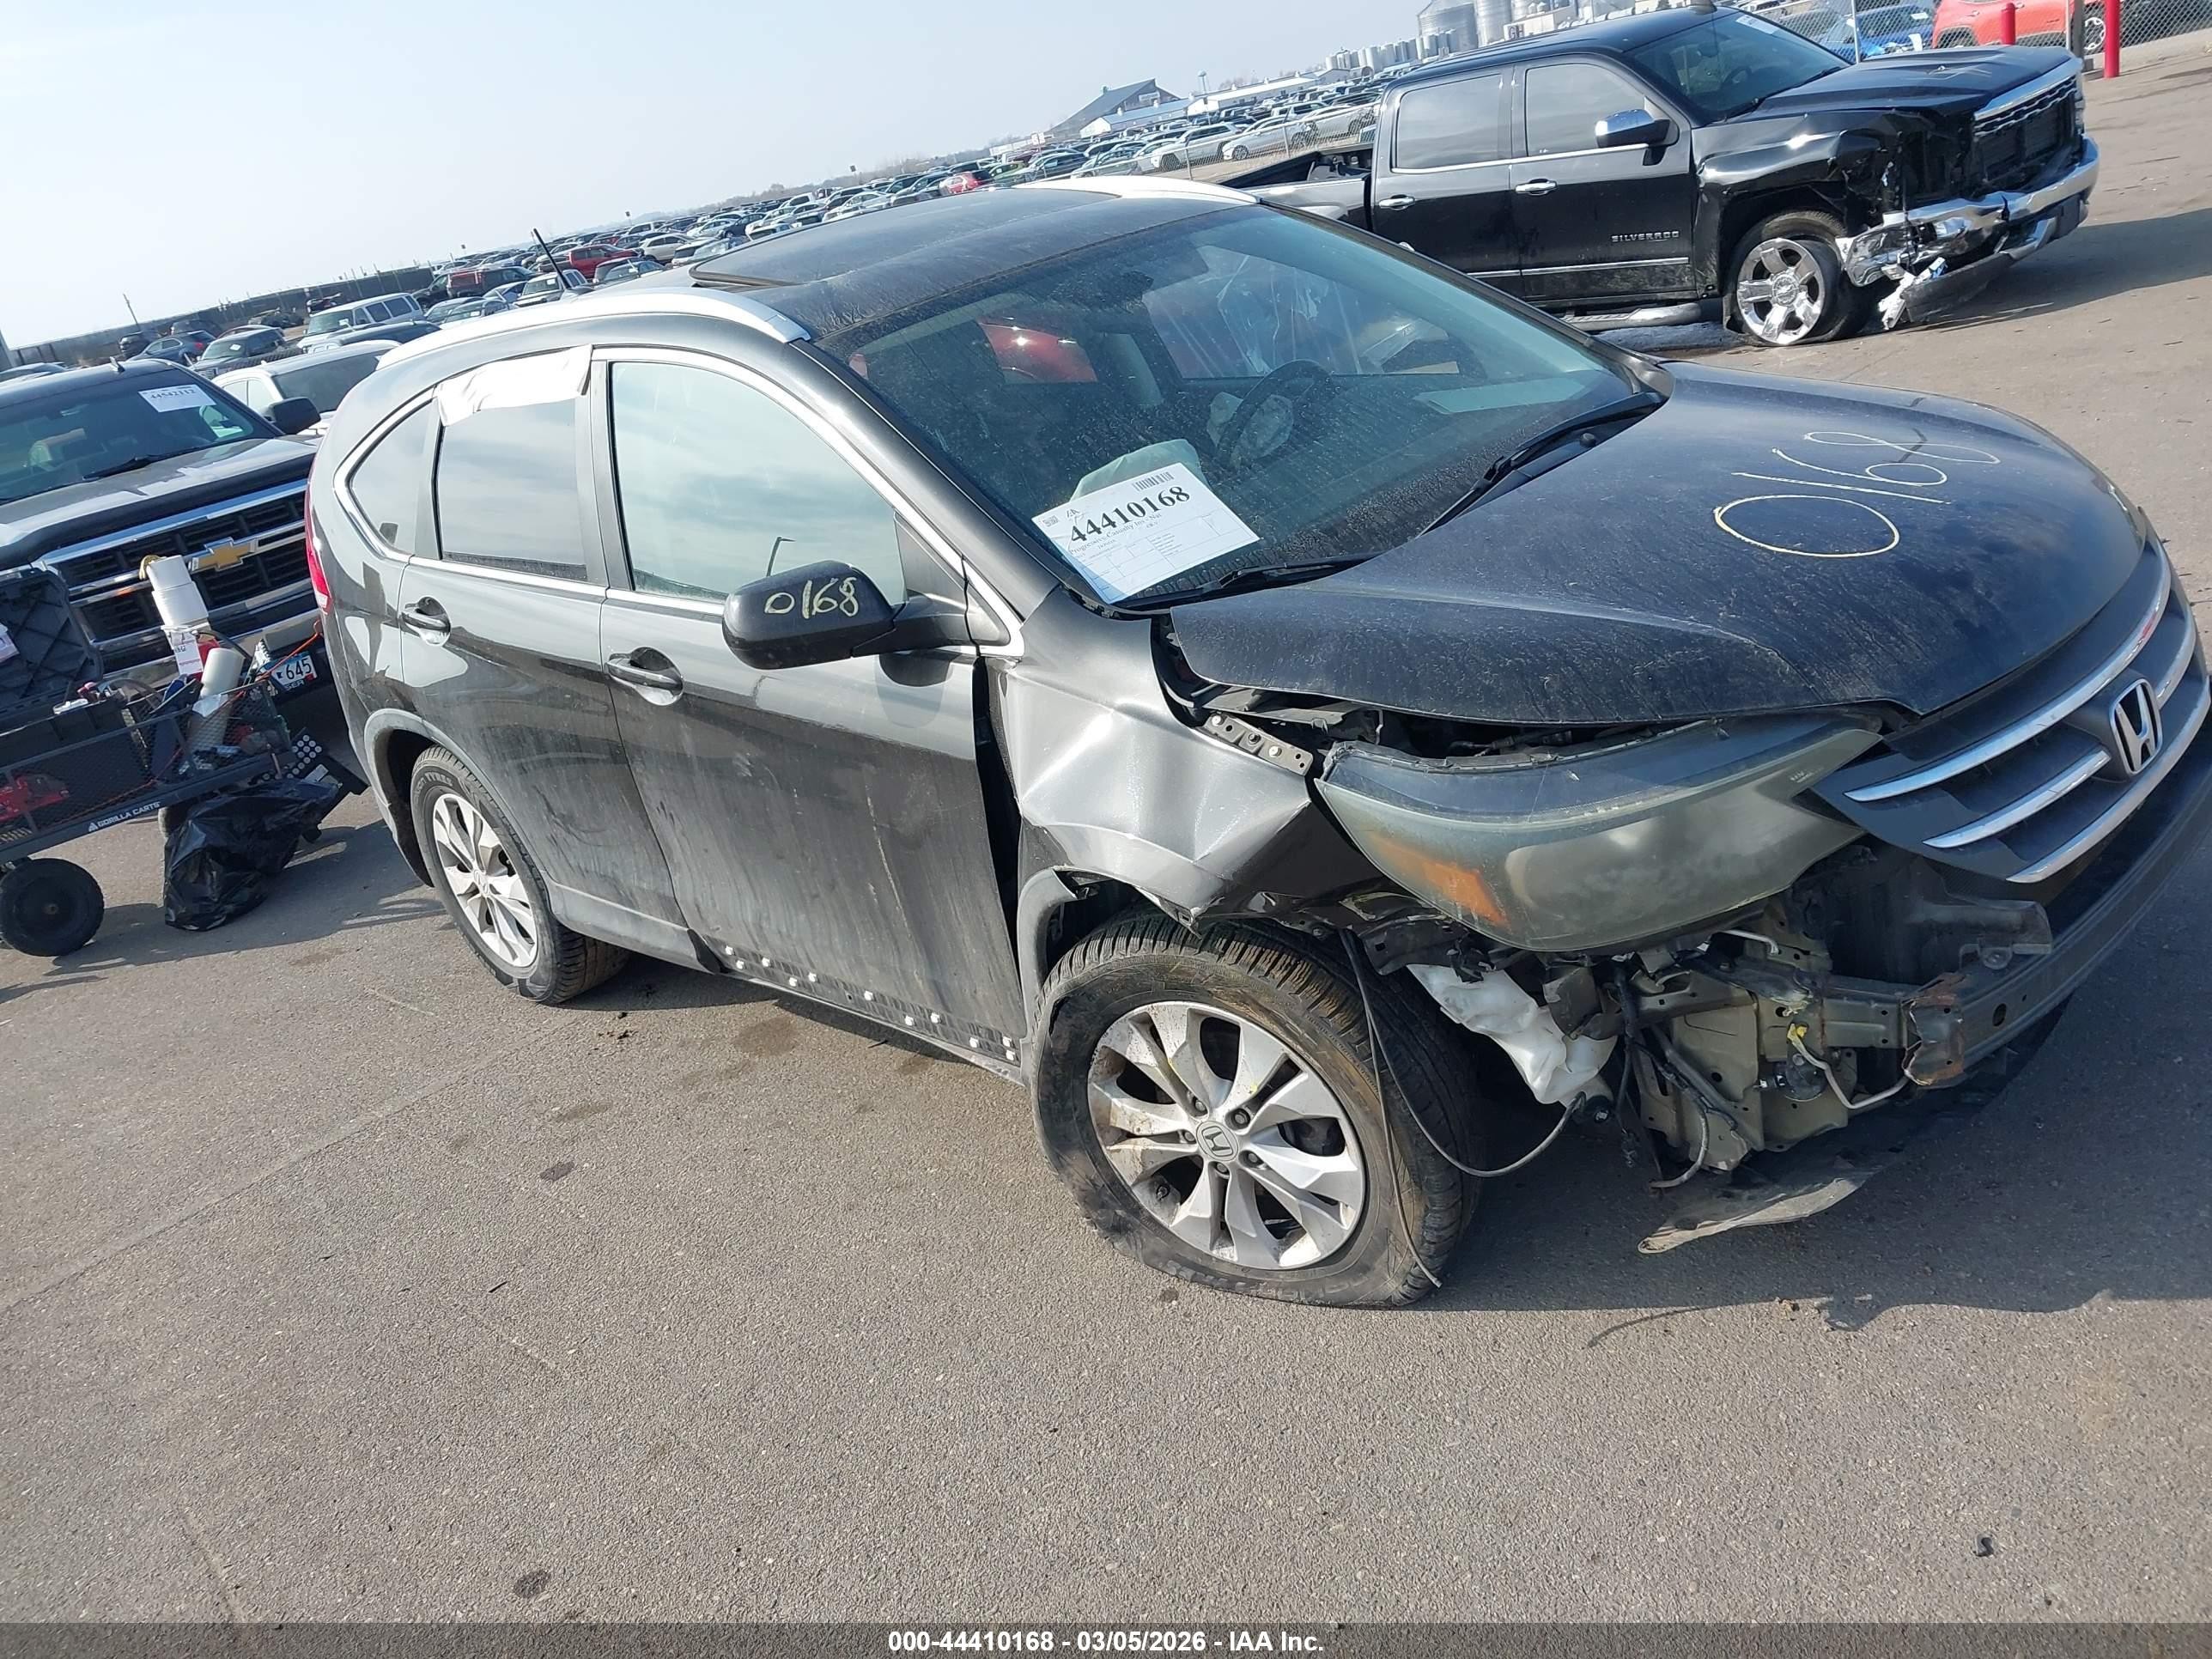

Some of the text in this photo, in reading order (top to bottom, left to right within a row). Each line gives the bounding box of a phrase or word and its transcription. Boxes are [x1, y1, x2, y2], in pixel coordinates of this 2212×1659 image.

[1611, 230, 1680, 242] SILVERADO
[1712, 430, 2002, 558] 0168
[1070, 486, 1191, 542] 44410168
[764, 577, 860, 619] 0168
[286, 659, 312, 680] 645
[97, 801, 161, 827] GORILLA CARTS
